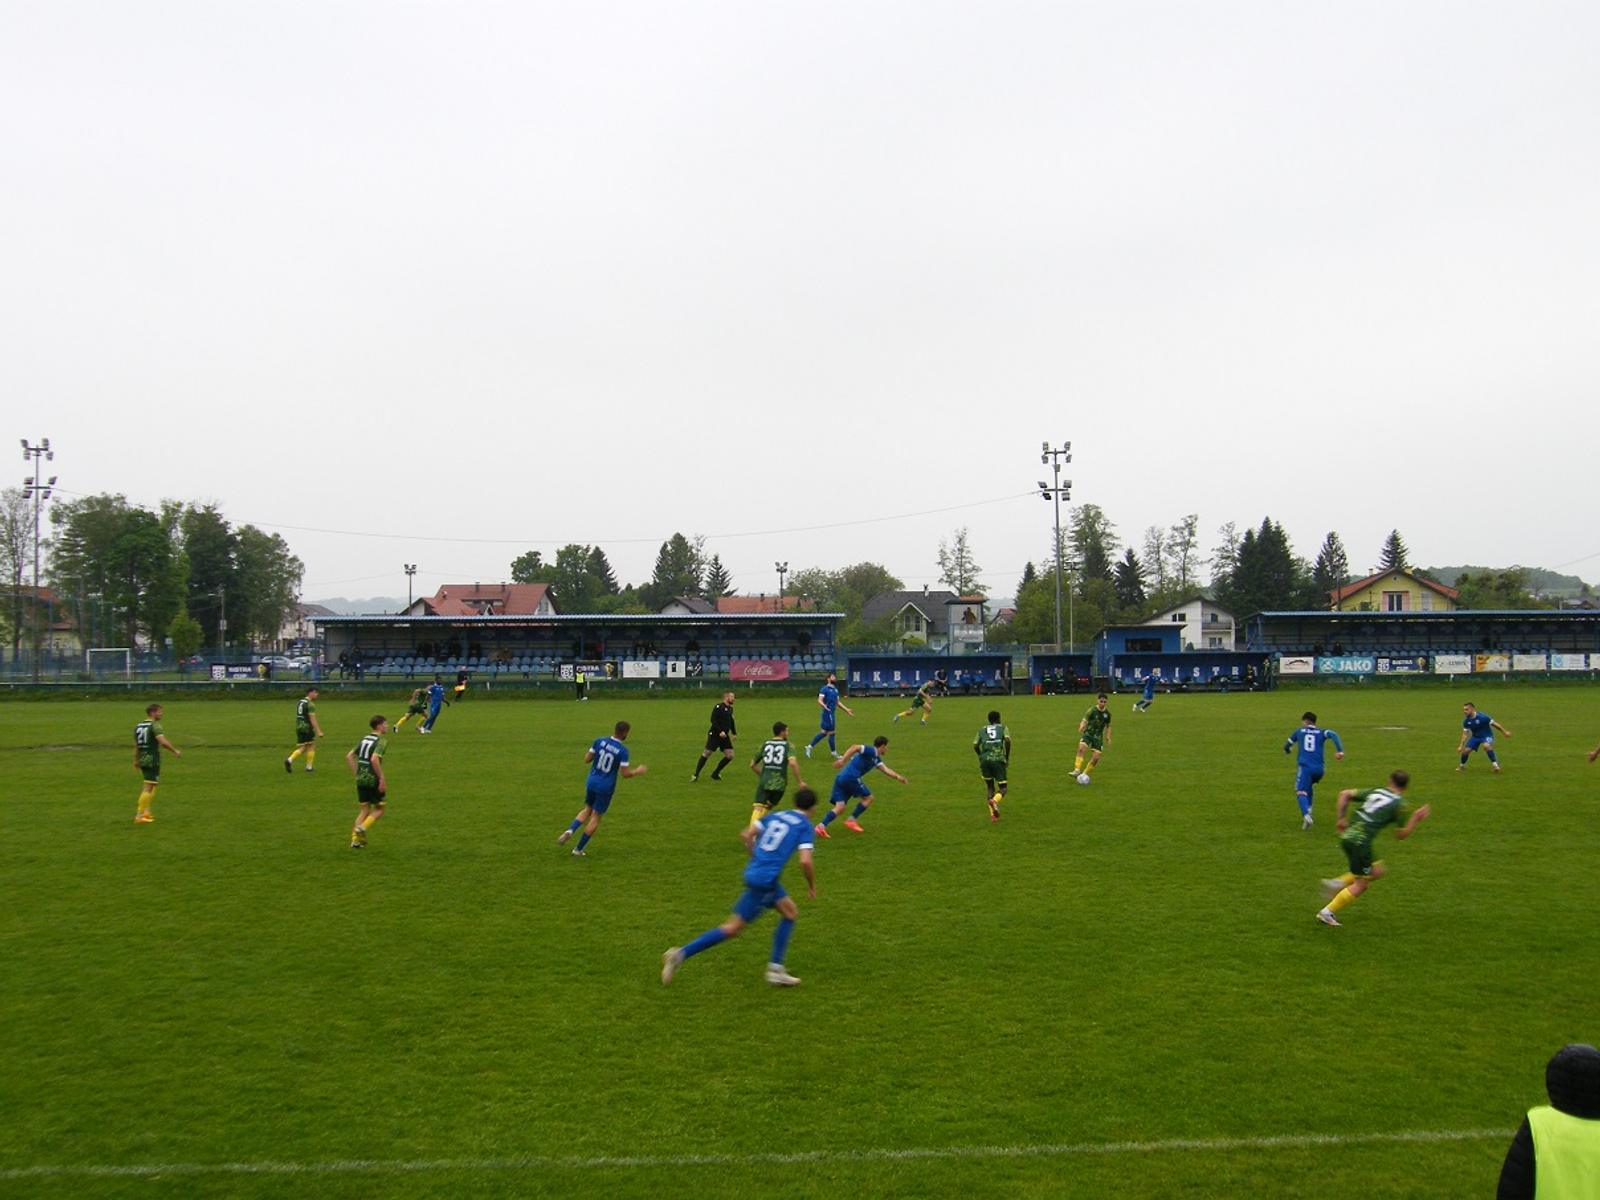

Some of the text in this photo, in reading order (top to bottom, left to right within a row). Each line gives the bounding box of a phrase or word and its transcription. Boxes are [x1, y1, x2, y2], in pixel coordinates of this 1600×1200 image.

[1337, 660, 1372, 671] JAKO
[136, 727, 149, 744] 21
[986, 725, 997, 739] 5
[359, 739, 374, 759] 17
[1304, 734, 1315, 752] 8
[597, 749, 614, 773] 10
[763, 744, 785, 764] 33
